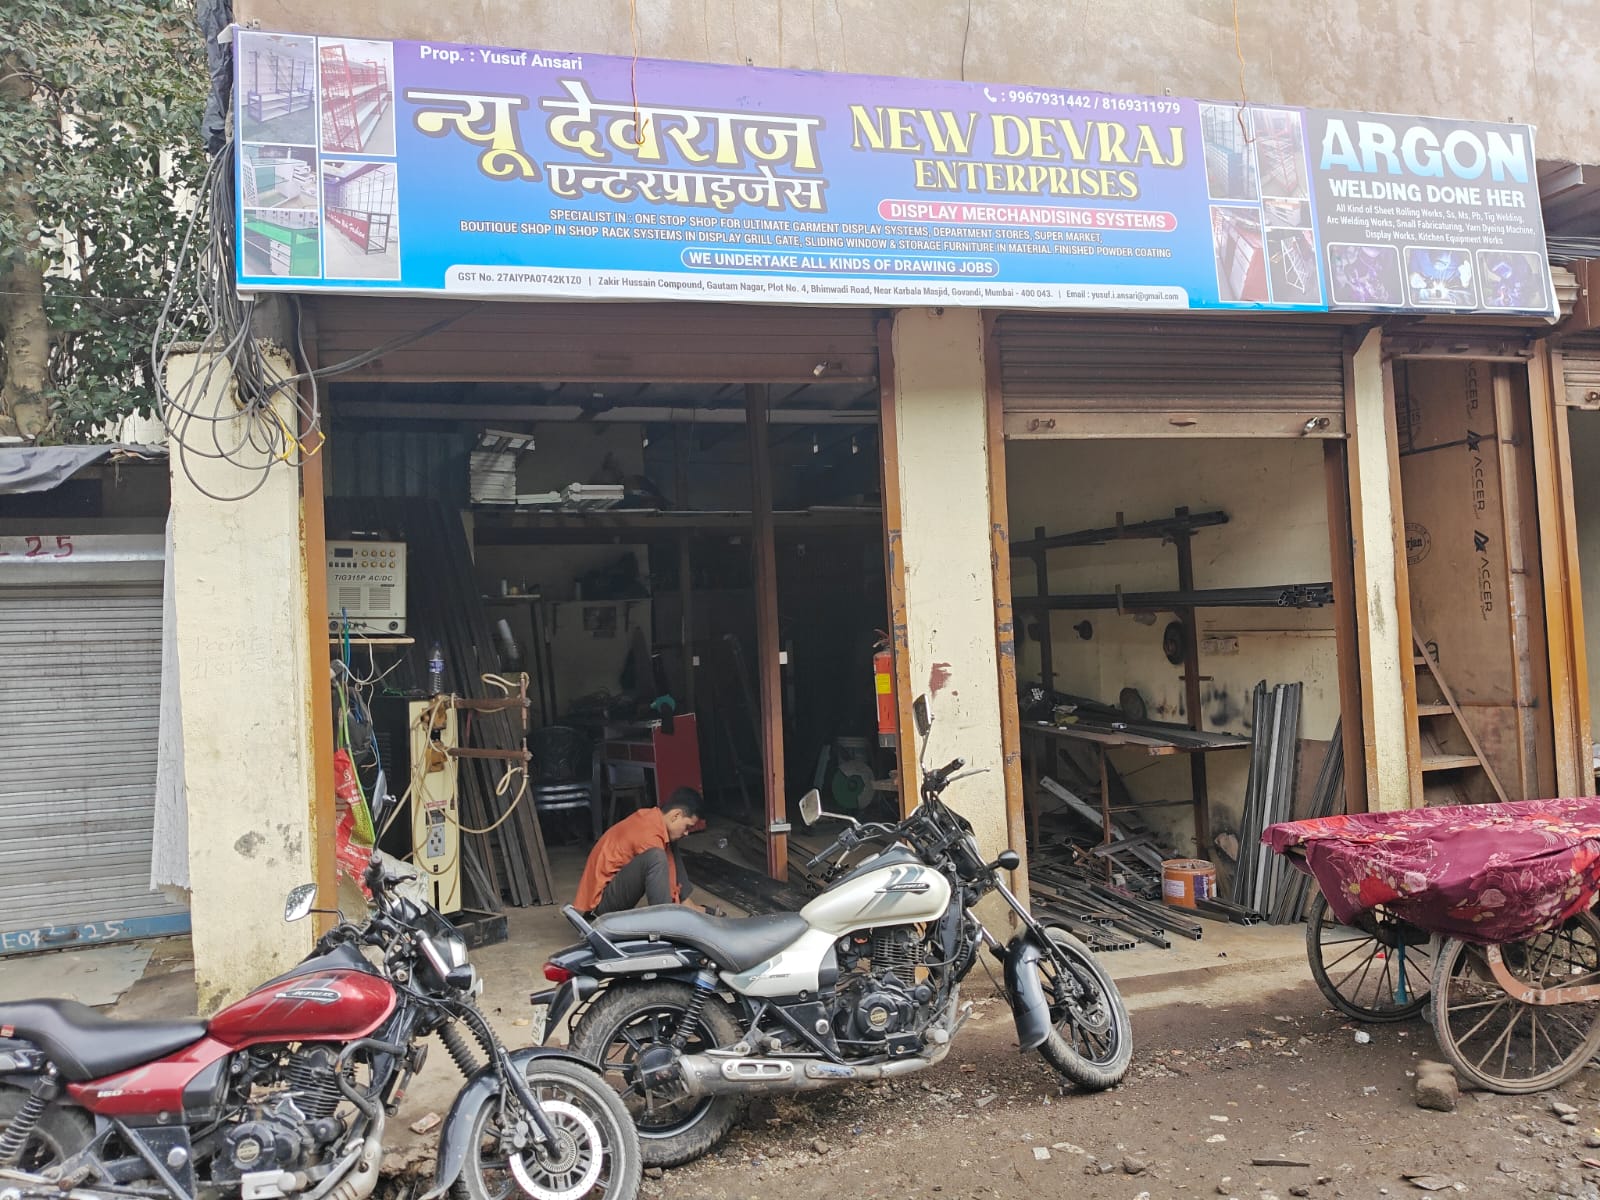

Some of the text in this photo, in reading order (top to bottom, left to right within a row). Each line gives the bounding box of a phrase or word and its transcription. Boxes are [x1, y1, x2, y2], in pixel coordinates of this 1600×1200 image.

[419, 45, 465, 63] Prop.
[479, 49, 527, 67] Yusuf
[530, 52, 583, 70] Ansari
[1008, 90, 1091, 109] 9967931442
[1101, 97, 1181, 115] 8169311979
[406, 79, 821, 178] न्यू देवराज
[849, 104, 1186, 167] NEW DEVRAJ
[1319, 118, 1529, 184] ARGON
[546, 164, 824, 210] एन्टरप्राइजेस
[913, 159, 1139, 198] ENTERPRISES
[1327, 178, 1526, 209] WELDING DONE HER
[549, 209, 614, 223] SPECIALIST
[614, 212, 627, 224] IN
[634, 213, 656, 225] ONE
[659, 214, 687, 226] STOP
[689, 216, 717, 228] SHOP
[720, 217, 741, 229] FOR
[743, 219, 790, 231] ULTIMATE
[792, 221, 840, 233] GARMENT
[842, 223, 882, 235] DISPLAY
[884, 225, 931, 238] SYSTEMS,
[933, 227, 993, 239] DEPARTMENT
[1034, 230, 1064, 241] SUPER
[890, 203, 1167, 229] DISPLAY MERCHANDISING SYSTEMS
[1327, 215, 1339, 224] Arc
[1340, 216, 1369, 228] Welding
[1397, 219, 1416, 228] Small
[1347, 204, 1364, 214] Kind
[1374, 205, 1395, 216] Sheet
[459, 220, 1172, 258] BOUTIQUE SHOP IN SHOP RACK SYSTEMS IN DISPLAY GRILL GATE, SLIDING WINDOW & STORAGE FURNITURE IN MATERIAL FINISHED POWDER COATING
[689, 251, 993, 274] WE UNDERTAKE ALL KINDS OF DRAWING JOBS
[458, 272, 476, 281] GST
[479, 272, 495, 282] No.
[598, 276, 620, 287] Zakir
[622, 278, 656, 288] Hussain
[658, 280, 705, 291] Compound,
[706, 280, 738, 291] Gautam
[740, 282, 766, 293] Nagar,
[767, 283, 784, 292] Plot
[786, 284, 800, 293] No.
[811, 285, 849, 295] Bhimwadi
[850, 286, 872, 296] Road,
[873, 286, 891, 295] Near
[893, 286, 922, 296] Karbala
[952, 288, 984, 298] Govandi,
[985, 288, 1014, 297] Mumbai
[1021, 289, 1035, 298] 400
[1066, 290, 1086, 298] Email
[1473, 456, 1486, 511] ACCER
[334, 574, 366, 582] TIG315P
[1480, 556, 1493, 613] ACCER
